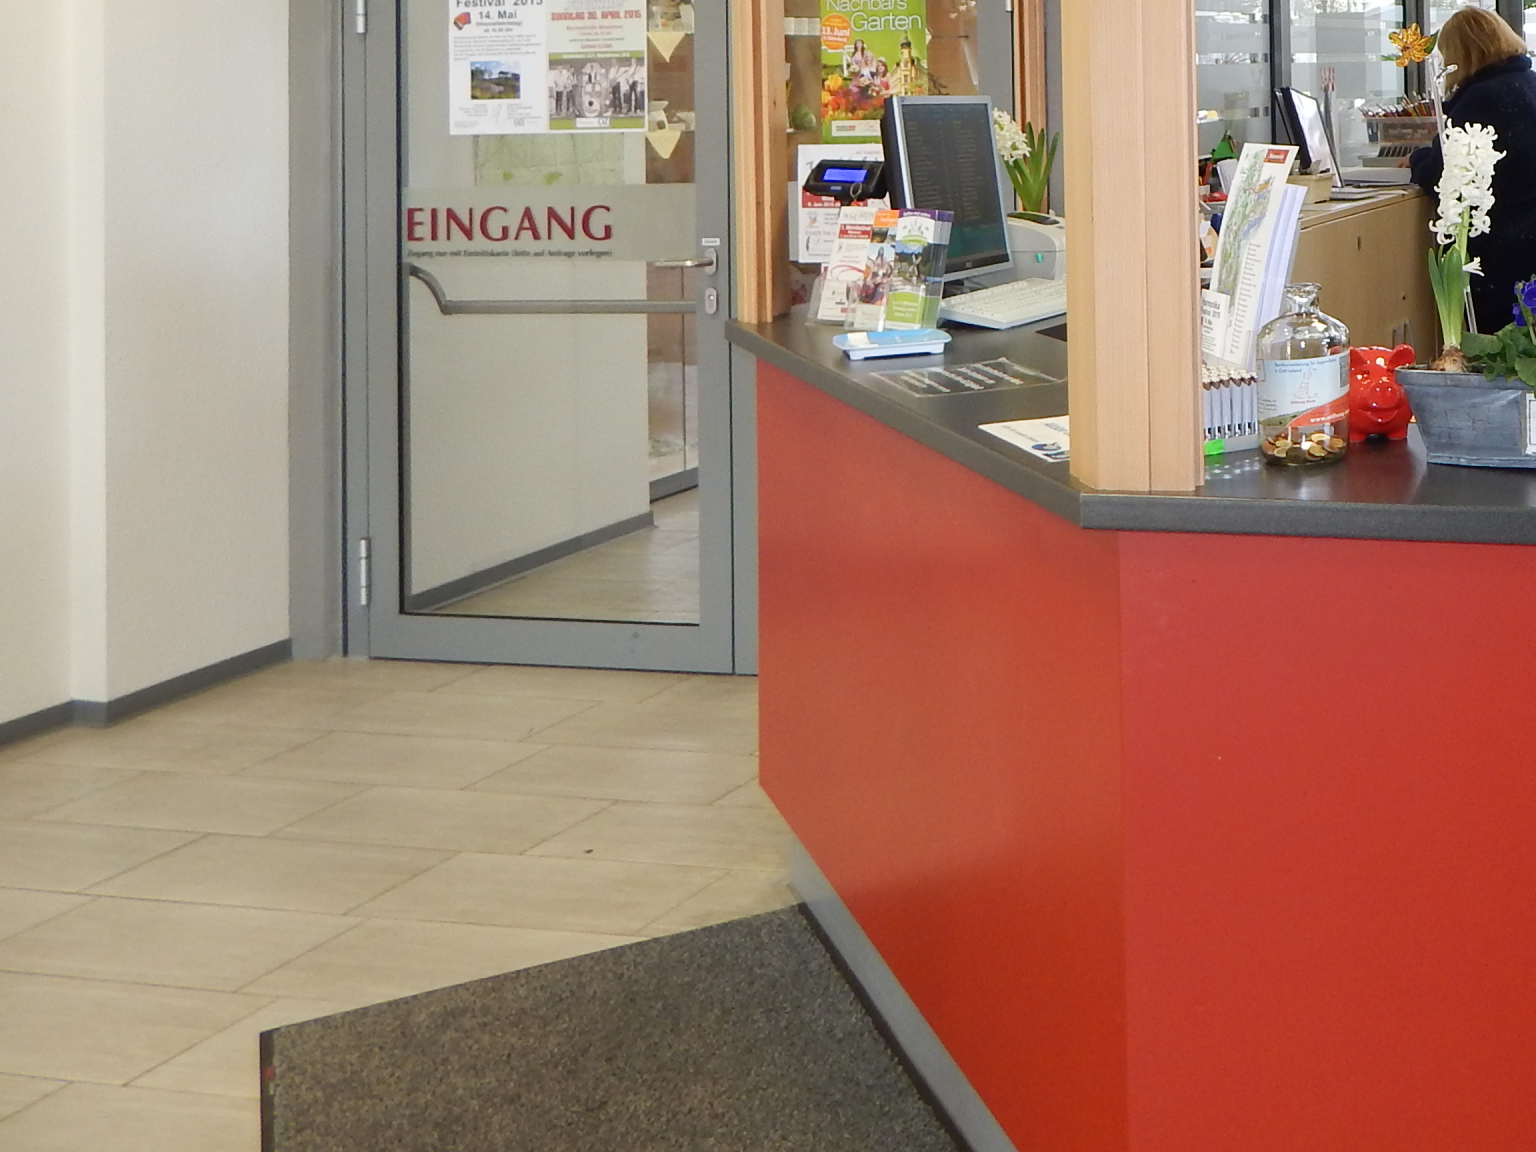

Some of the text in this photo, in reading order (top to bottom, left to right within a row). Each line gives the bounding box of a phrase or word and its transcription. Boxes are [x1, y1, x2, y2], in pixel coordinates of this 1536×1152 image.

[479, 10, 517, 20] 14. Mai
[851, 12, 922, 32] Garten
[406, 205, 612, 241] EINGANG
